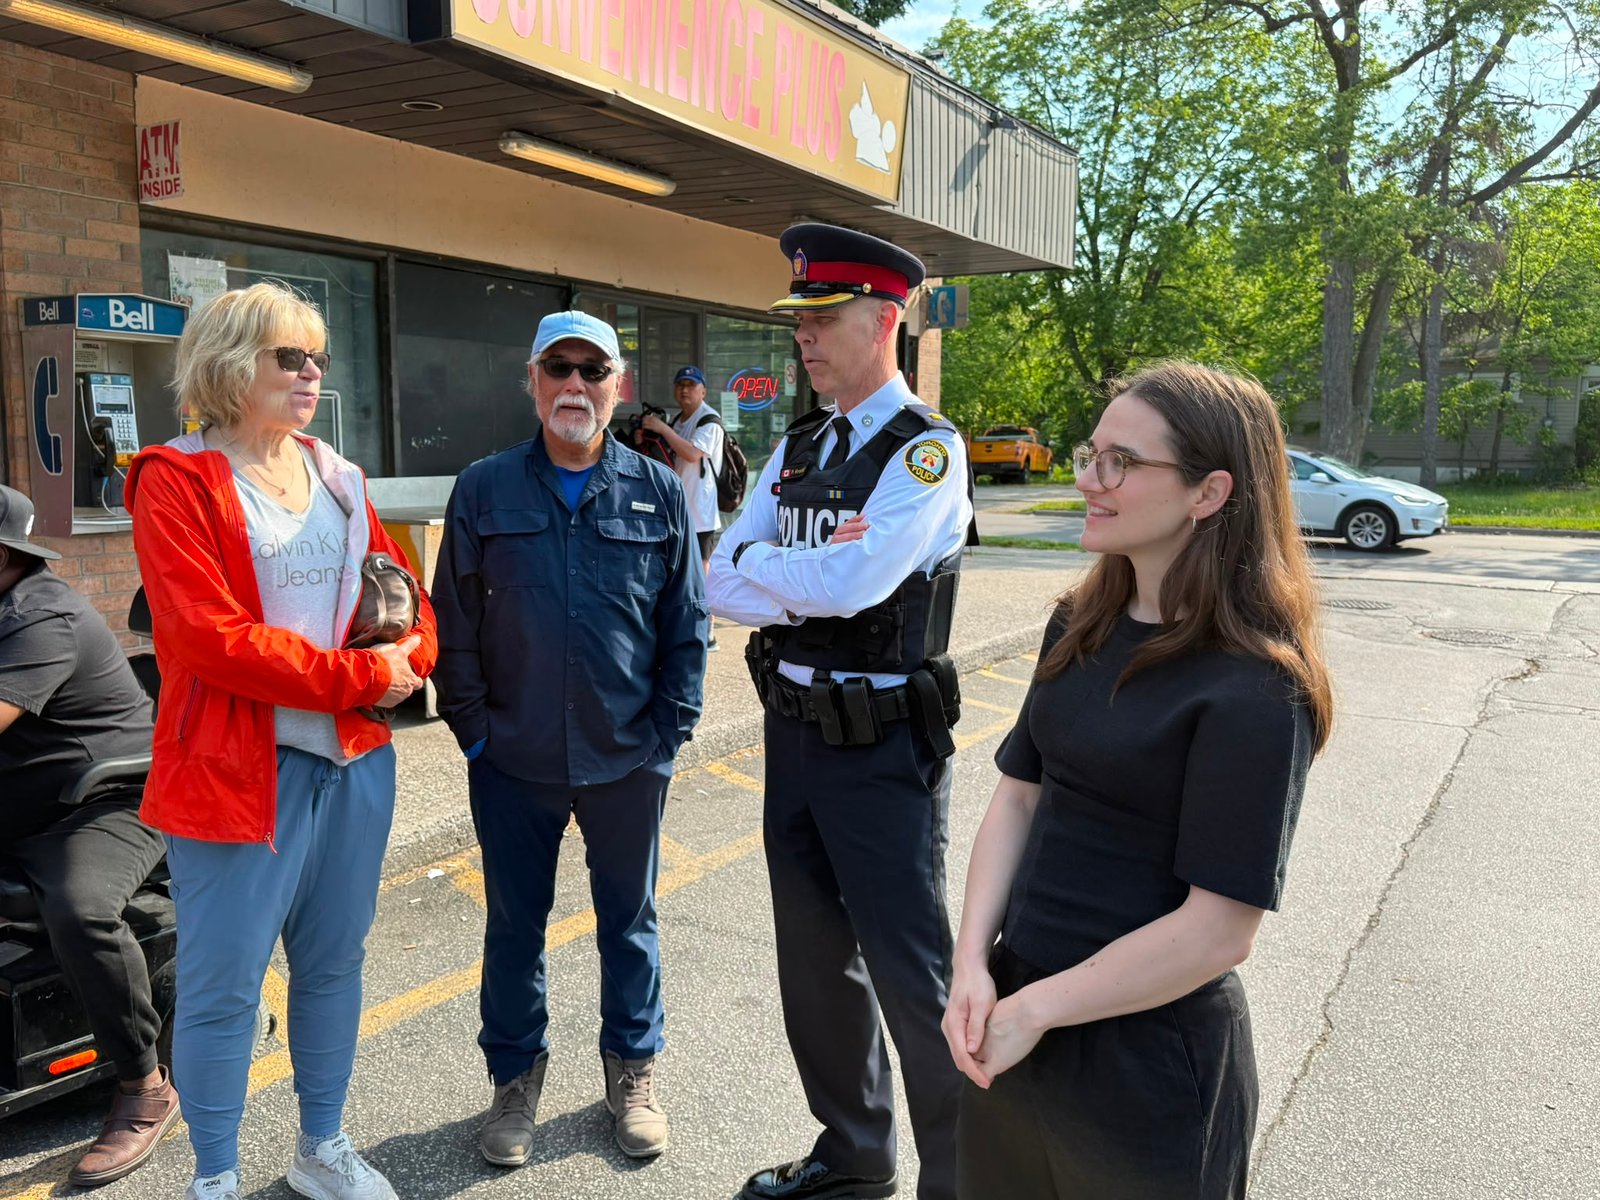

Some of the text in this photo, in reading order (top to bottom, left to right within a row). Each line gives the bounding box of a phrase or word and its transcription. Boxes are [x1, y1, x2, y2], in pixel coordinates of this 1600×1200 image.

[469, 0, 846, 162] VENIENCE PLUS
[140, 122, 179, 180] ATM
[140, 178, 180, 199] INSIDE
[39, 301, 59, 321] Bell
[108, 299, 154, 331] Bell
[733, 377, 779, 399] OPEN
[916, 440, 947, 457] TORONTO
[912, 465, 936, 481] POLICE
[202, 1179, 221, 1188] HOKA
